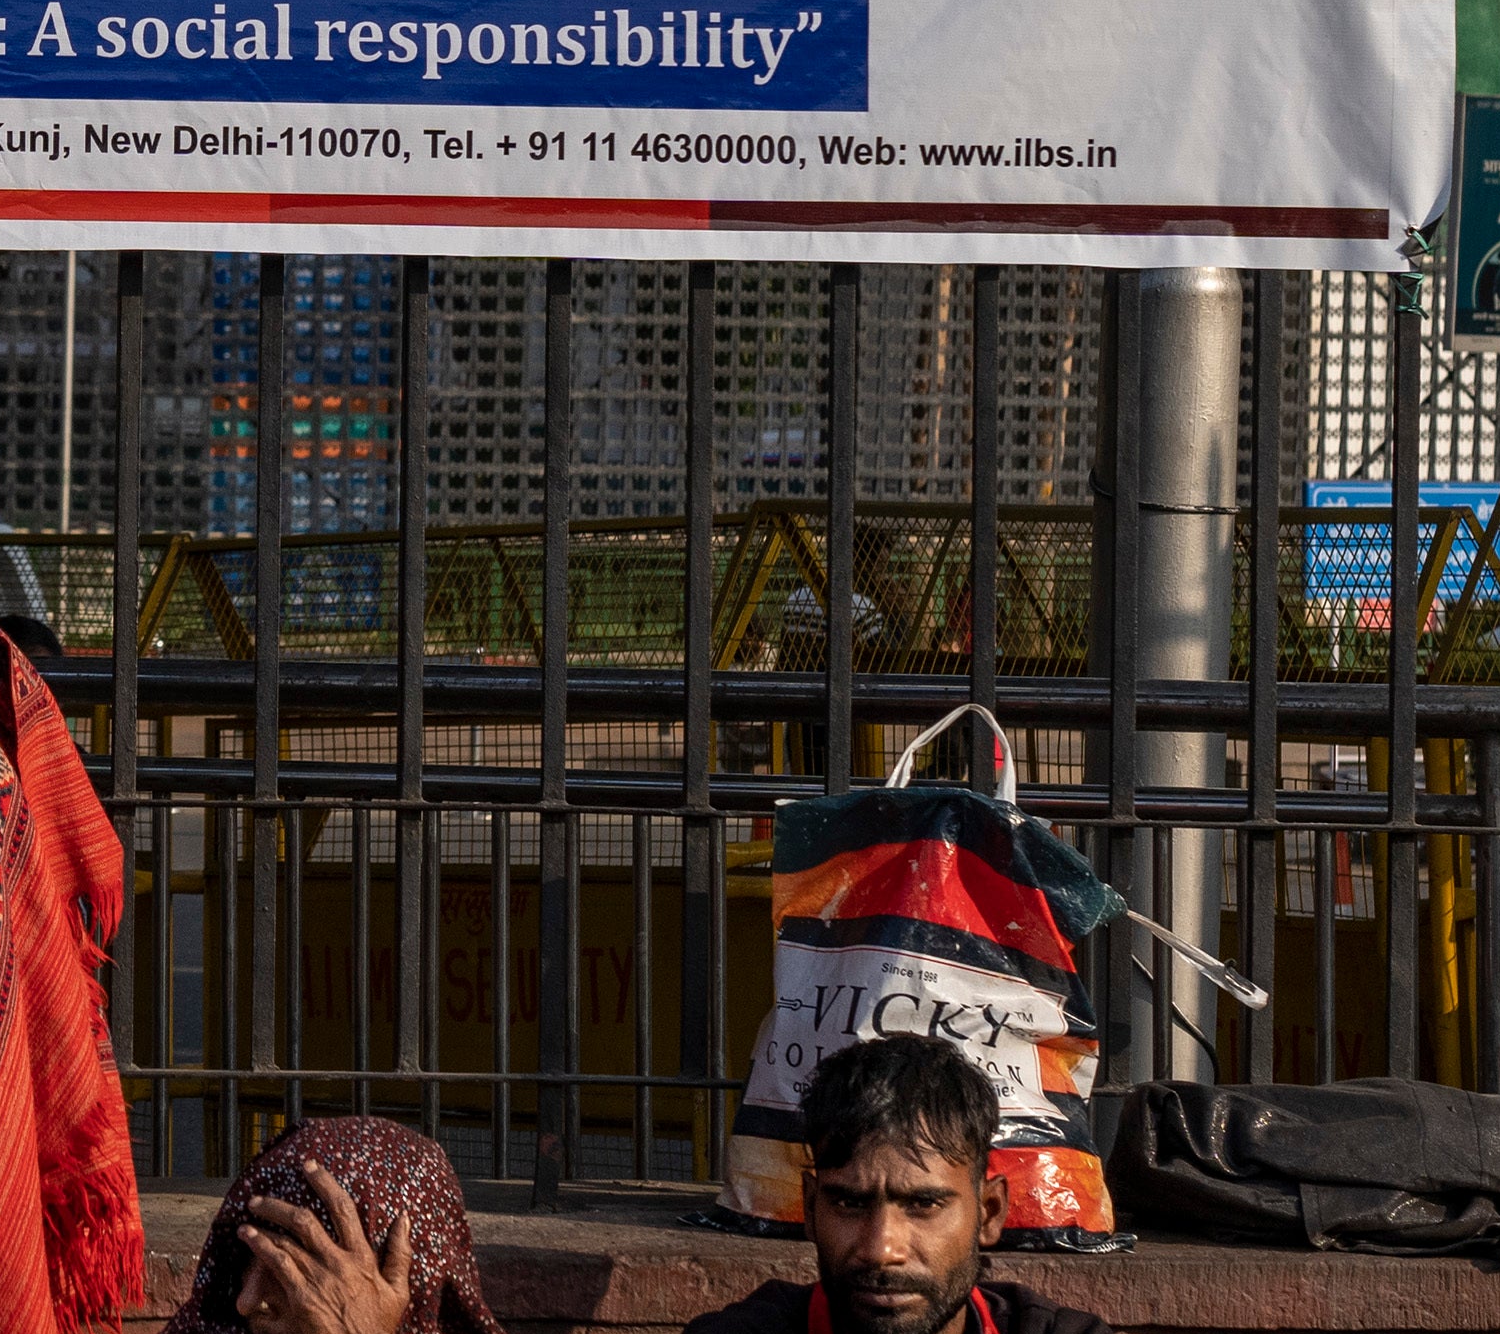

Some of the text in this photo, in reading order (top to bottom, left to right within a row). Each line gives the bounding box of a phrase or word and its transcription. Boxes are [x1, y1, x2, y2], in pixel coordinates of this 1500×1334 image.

[29, 1, 78, 58] A
[97, 3, 294, 61] social
[315, 10, 824, 86] responsibility”
[85, 124, 163, 156] New
[174, 125, 413, 166] Delhi-110070,
[424, 130, 486, 162] Tel.
[497, 135, 518, 157] +
[529, 132, 567, 162] 91
[583, 134, 617, 163] 11
[631, 135, 808, 171] 46300000,
[819, 139, 910, 168] Web:
[919, 142, 1118, 171] www.ilbs.in
[880, 962, 939, 984] Since 1998
[813, 984, 1013, 1049] VICKY
